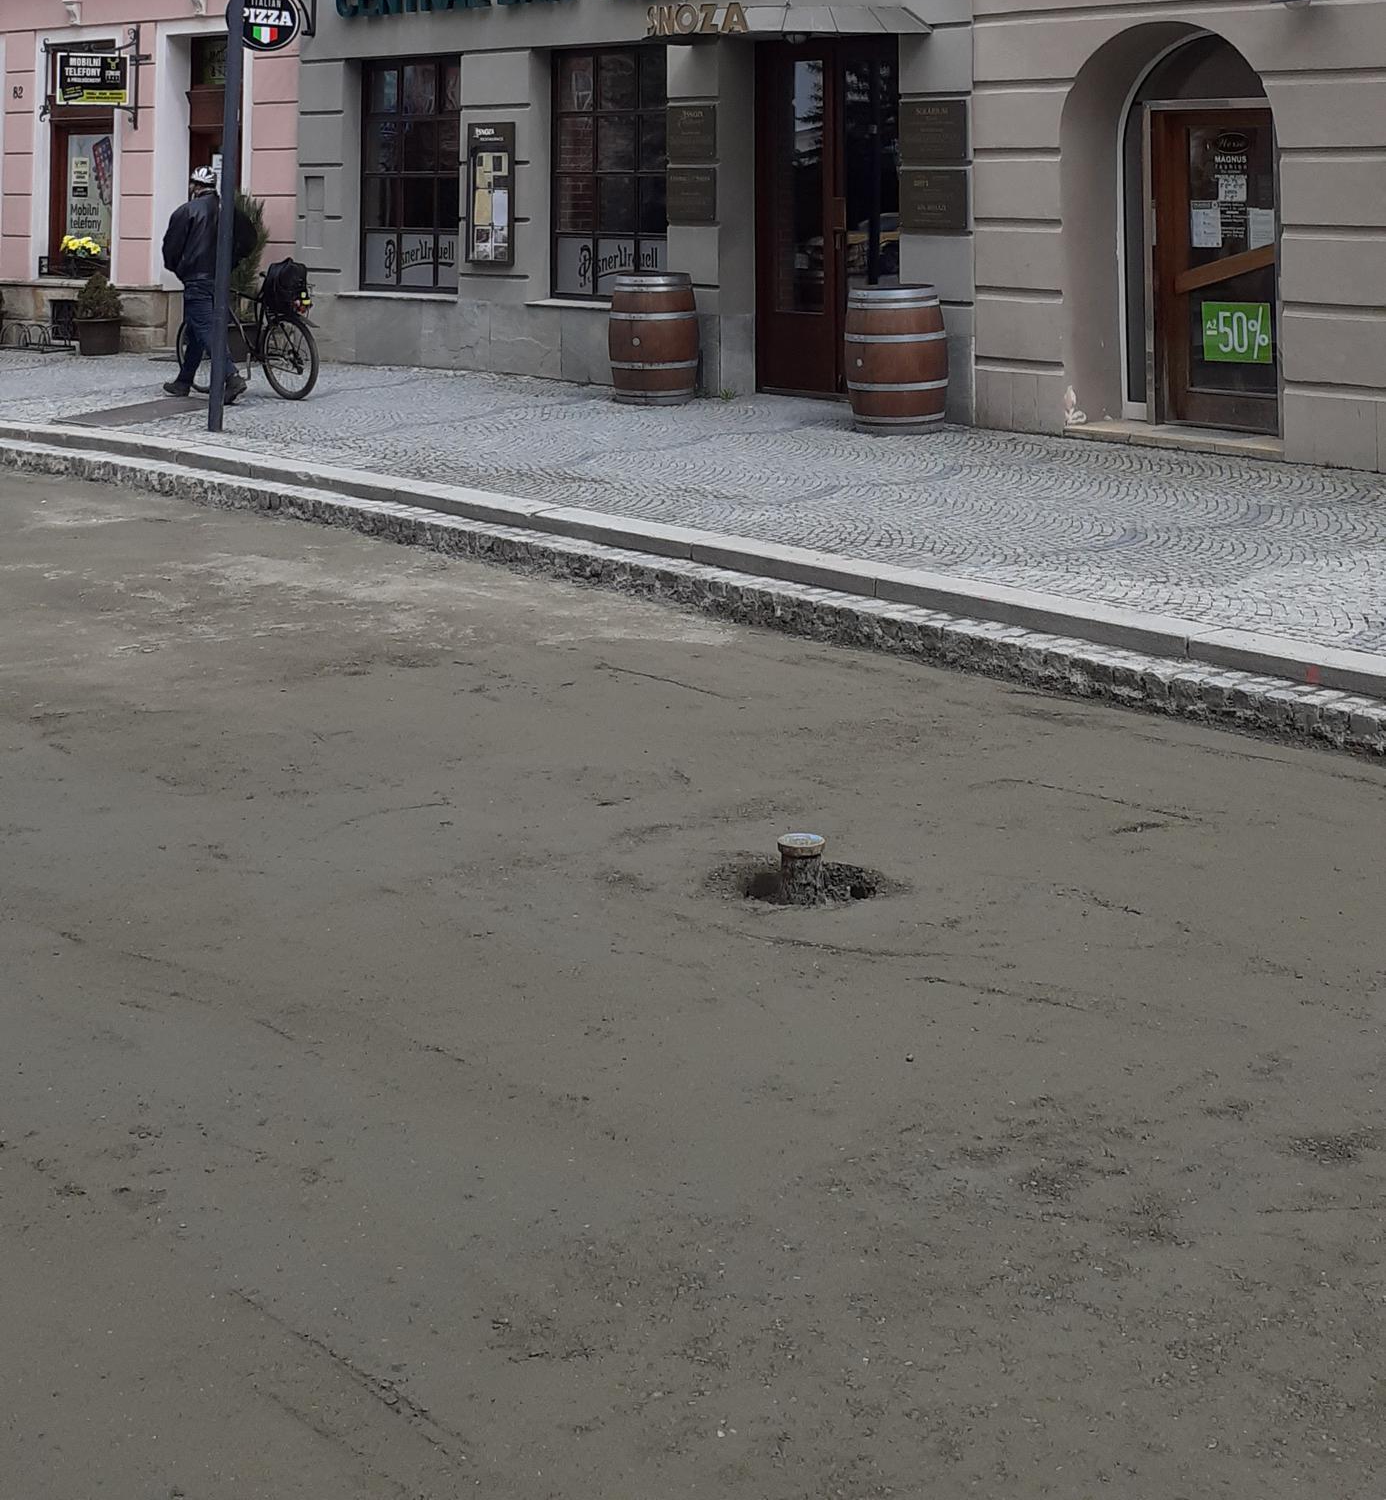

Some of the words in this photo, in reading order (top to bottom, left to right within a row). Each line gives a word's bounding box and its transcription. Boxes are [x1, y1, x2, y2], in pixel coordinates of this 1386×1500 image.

[646, 1, 749, 36] SNOZA
[64, 66, 102, 77] TELEFONY
[1214, 155, 1247, 164] MAGNUS
[70, 217, 102, 232] telefony
